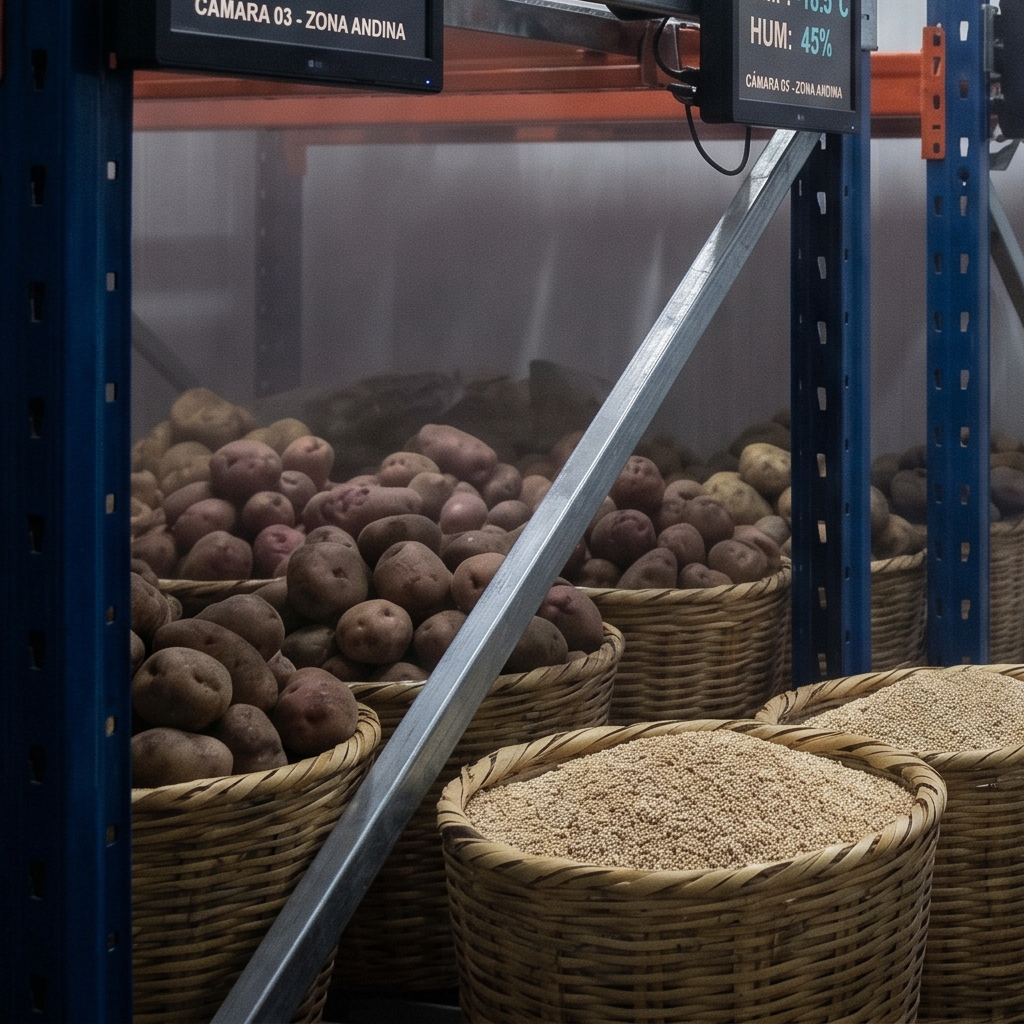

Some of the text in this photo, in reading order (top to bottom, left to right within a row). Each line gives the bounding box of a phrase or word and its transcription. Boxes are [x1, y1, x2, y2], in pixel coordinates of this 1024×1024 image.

[273, 6, 293, 26] 03
[305, 10, 349, 34] ZONA
[351, 17, 406, 41] ANDINA
[750, 16, 833, 57] HUM: 45%
